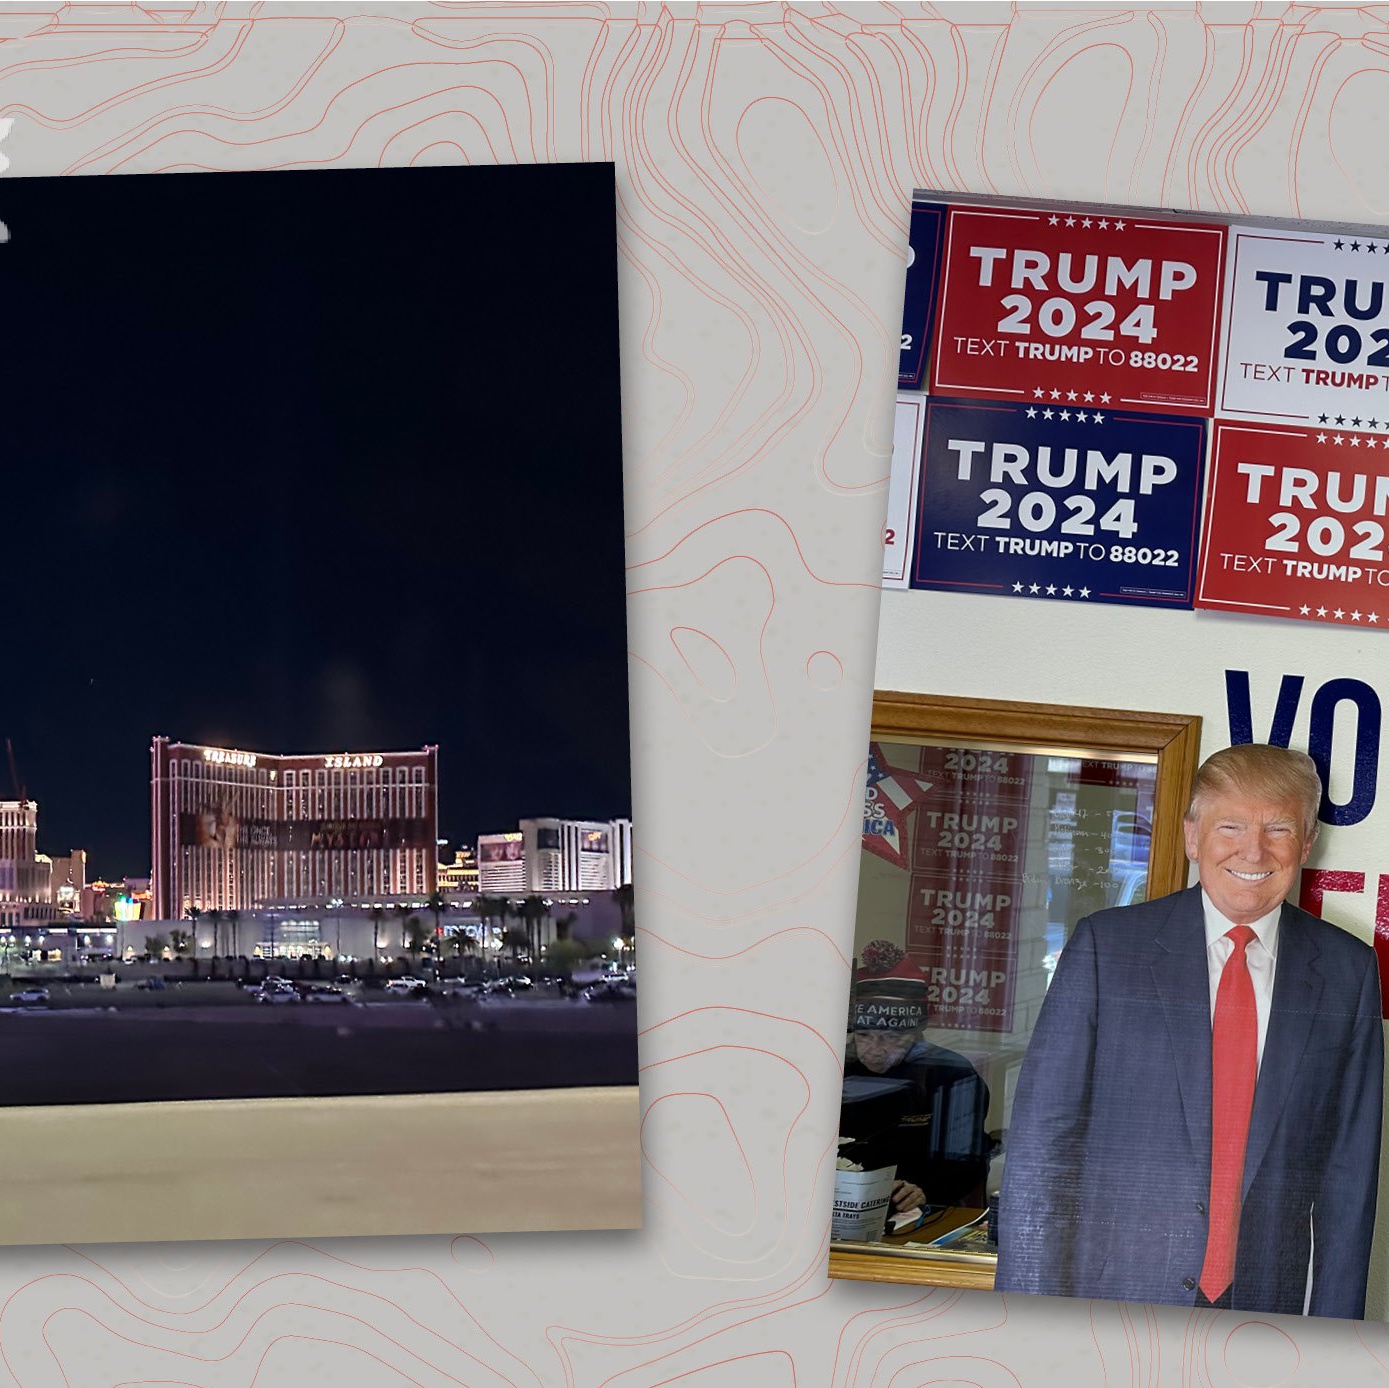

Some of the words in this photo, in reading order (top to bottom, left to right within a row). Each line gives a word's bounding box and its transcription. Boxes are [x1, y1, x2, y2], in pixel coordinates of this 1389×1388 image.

[969, 246, 1198, 300] TRUMP
[996, 294, 1158, 345] 2024
[954, 336, 1010, 358] TEXT
[1015, 341, 1094, 364] TRUMP
[1096, 347, 1125, 366] TO
[1129, 351, 1199, 373] 88022
[1240, 363, 1296, 385] TEXT
[1301, 368, 1380, 391] TRUMP
[947, 439, 1177, 495] TRUMP
[976, 488, 1138, 538] 2024
[933, 531, 990, 552] TEXT
[995, 537, 1074, 559] TRUMP
[1076, 542, 1106, 562] TO
[1110, 545, 1179, 567] 88022
[1221, 553, 1277, 574] TEXT
[1283, 559, 1362, 583] TRUMP
[203, 749, 257, 768] TREASURE
[324, 755, 384, 768] ISLAND
[944, 753, 1009, 774] 2024
[927, 811, 1018, 834] TRUMP
[937, 831, 1002, 851] 2024
[920, 889, 1011, 911] TRUMP
[931, 908, 995, 928] 2024
[920, 966, 1006, 988] RUMP
[927, 985, 990, 1005] 2024
[866, 1004, 922, 1016] AMERICA
[834, 1200, 859, 1209] STSIDE
